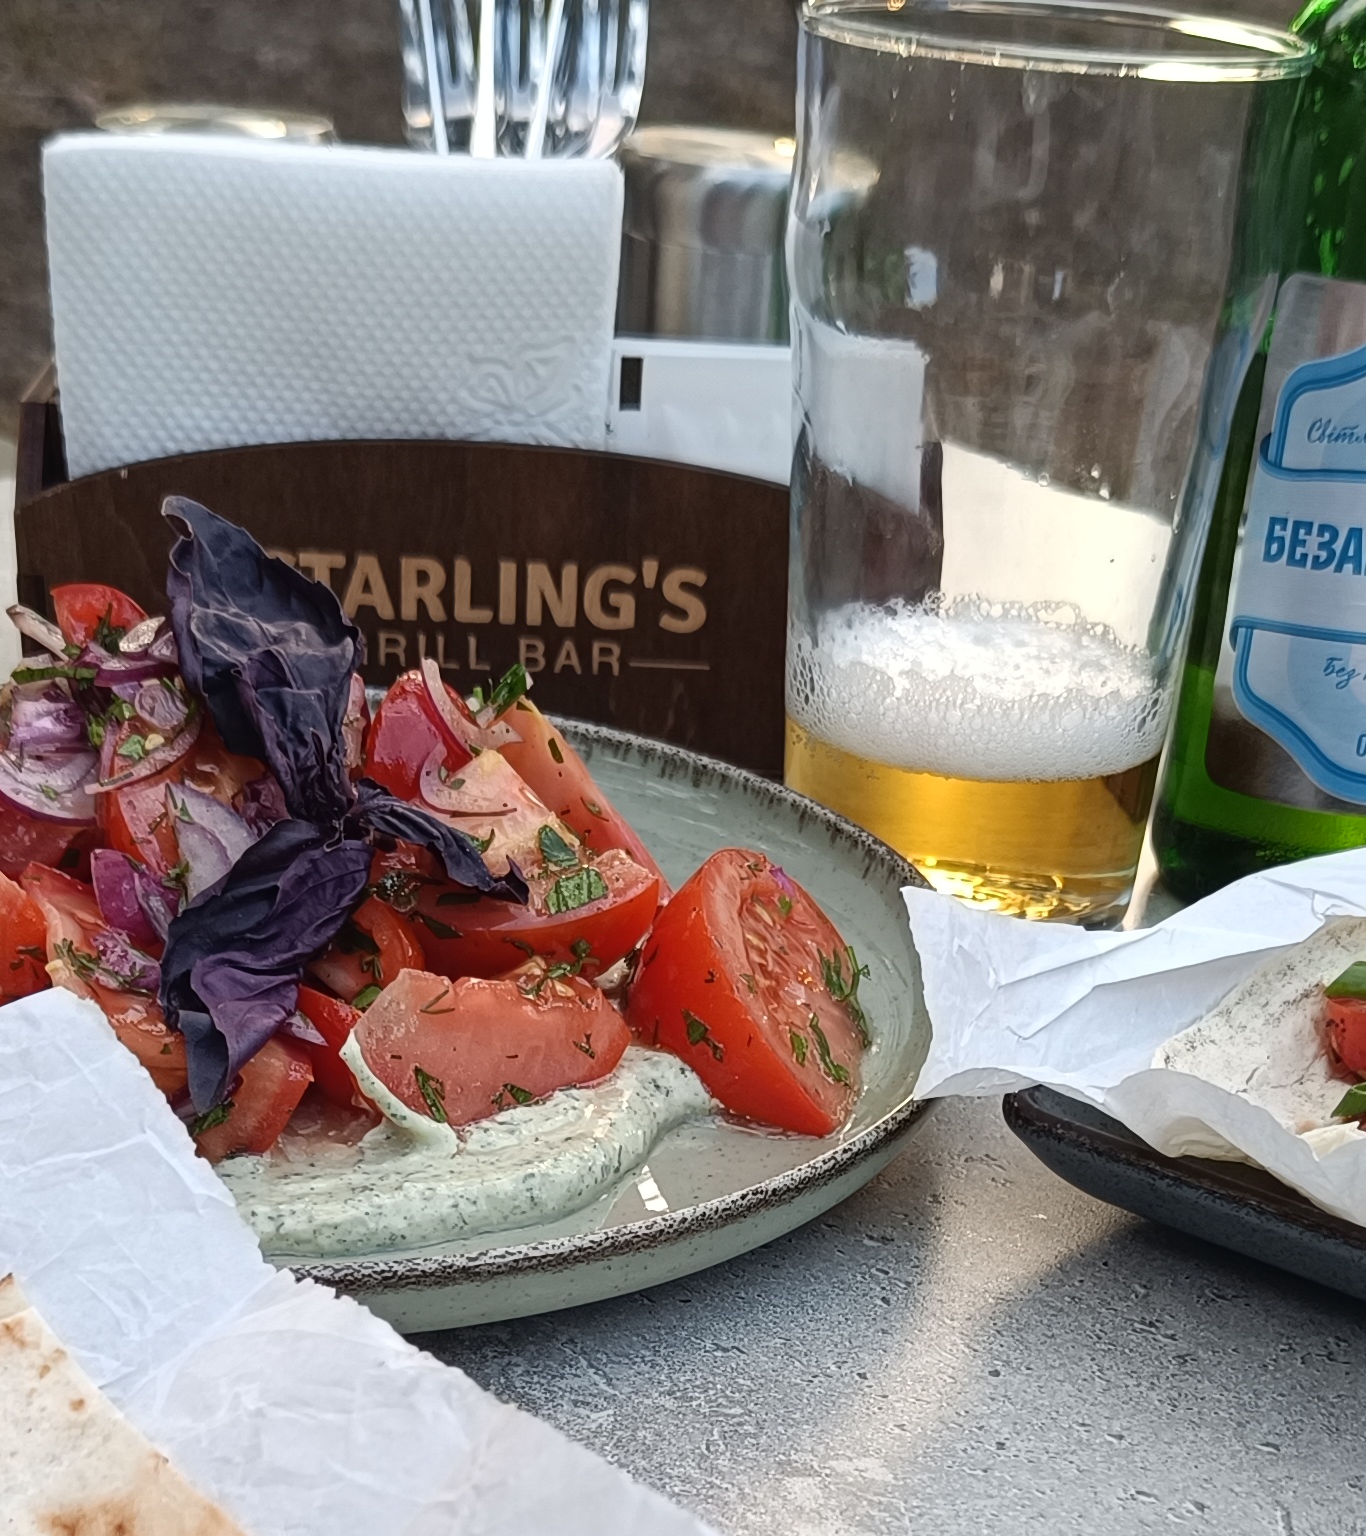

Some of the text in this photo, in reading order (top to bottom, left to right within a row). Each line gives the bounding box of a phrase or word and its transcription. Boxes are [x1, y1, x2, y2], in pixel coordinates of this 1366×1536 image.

[267, 551, 707, 633] TARLING'S
[362, 630, 621, 676] RILL BAR
[1323, 657, 1362, 690] Без
